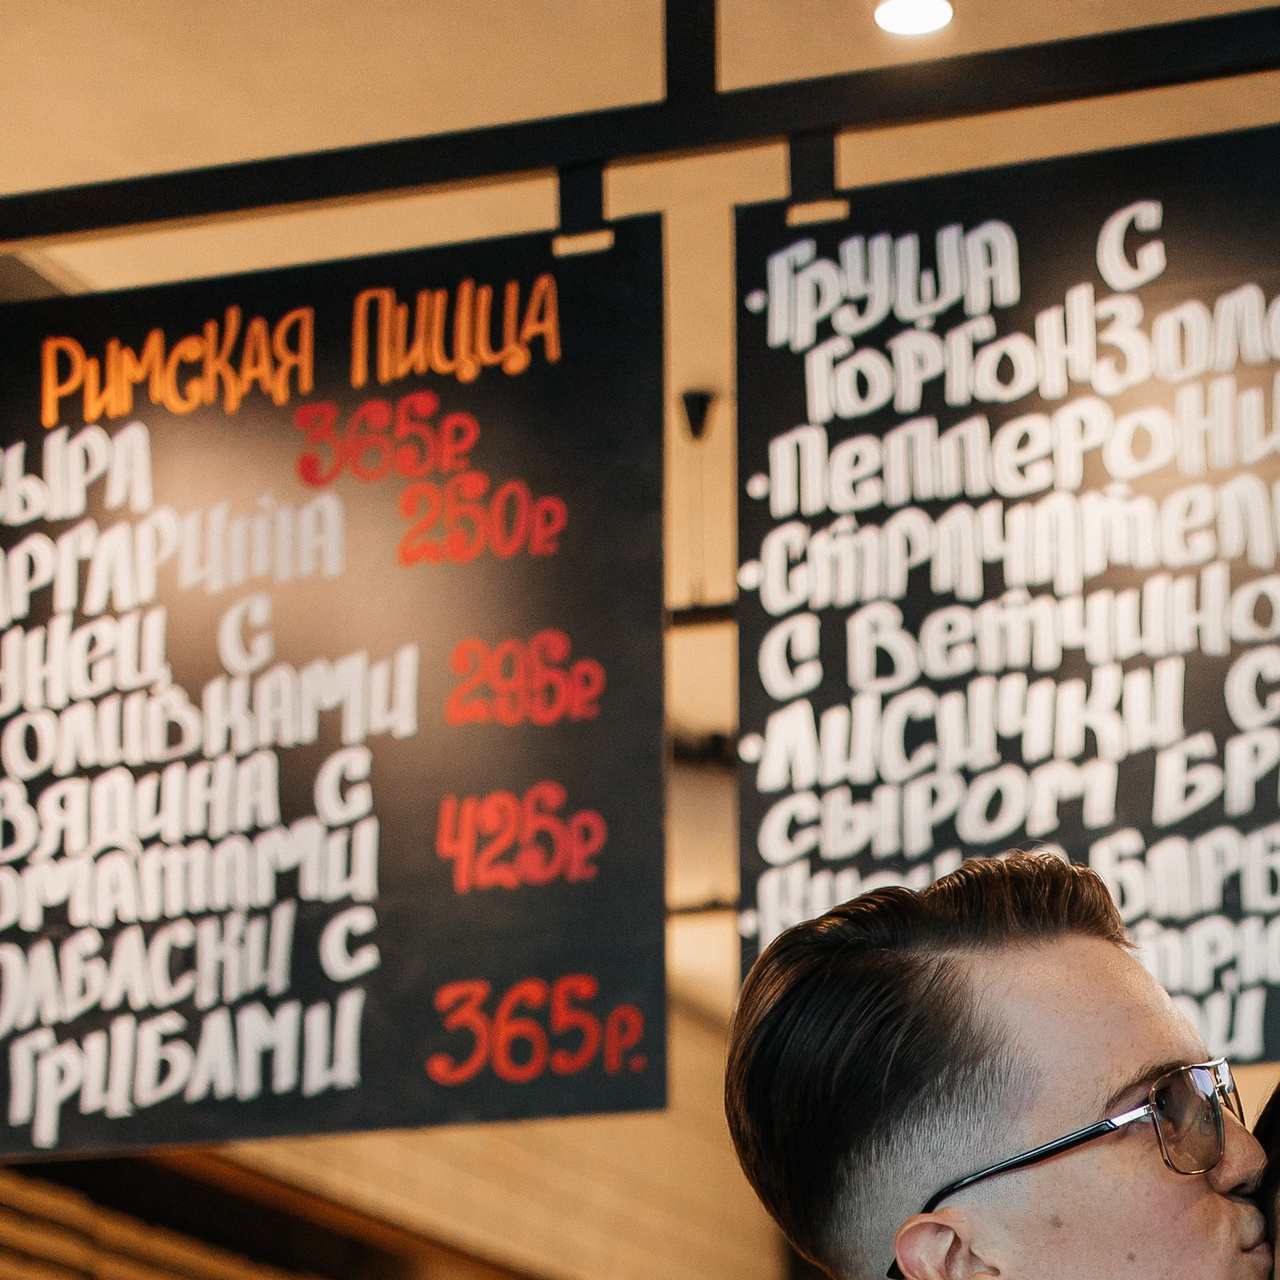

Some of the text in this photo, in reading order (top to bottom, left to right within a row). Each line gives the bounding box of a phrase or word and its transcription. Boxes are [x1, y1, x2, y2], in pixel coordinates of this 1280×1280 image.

[41, 274, 560, 428] РИМСКАЯ ПИЦЦА
[0, 420, 152, 526] ЫРА
[0, 491, 345, 630] РГАРИТА
